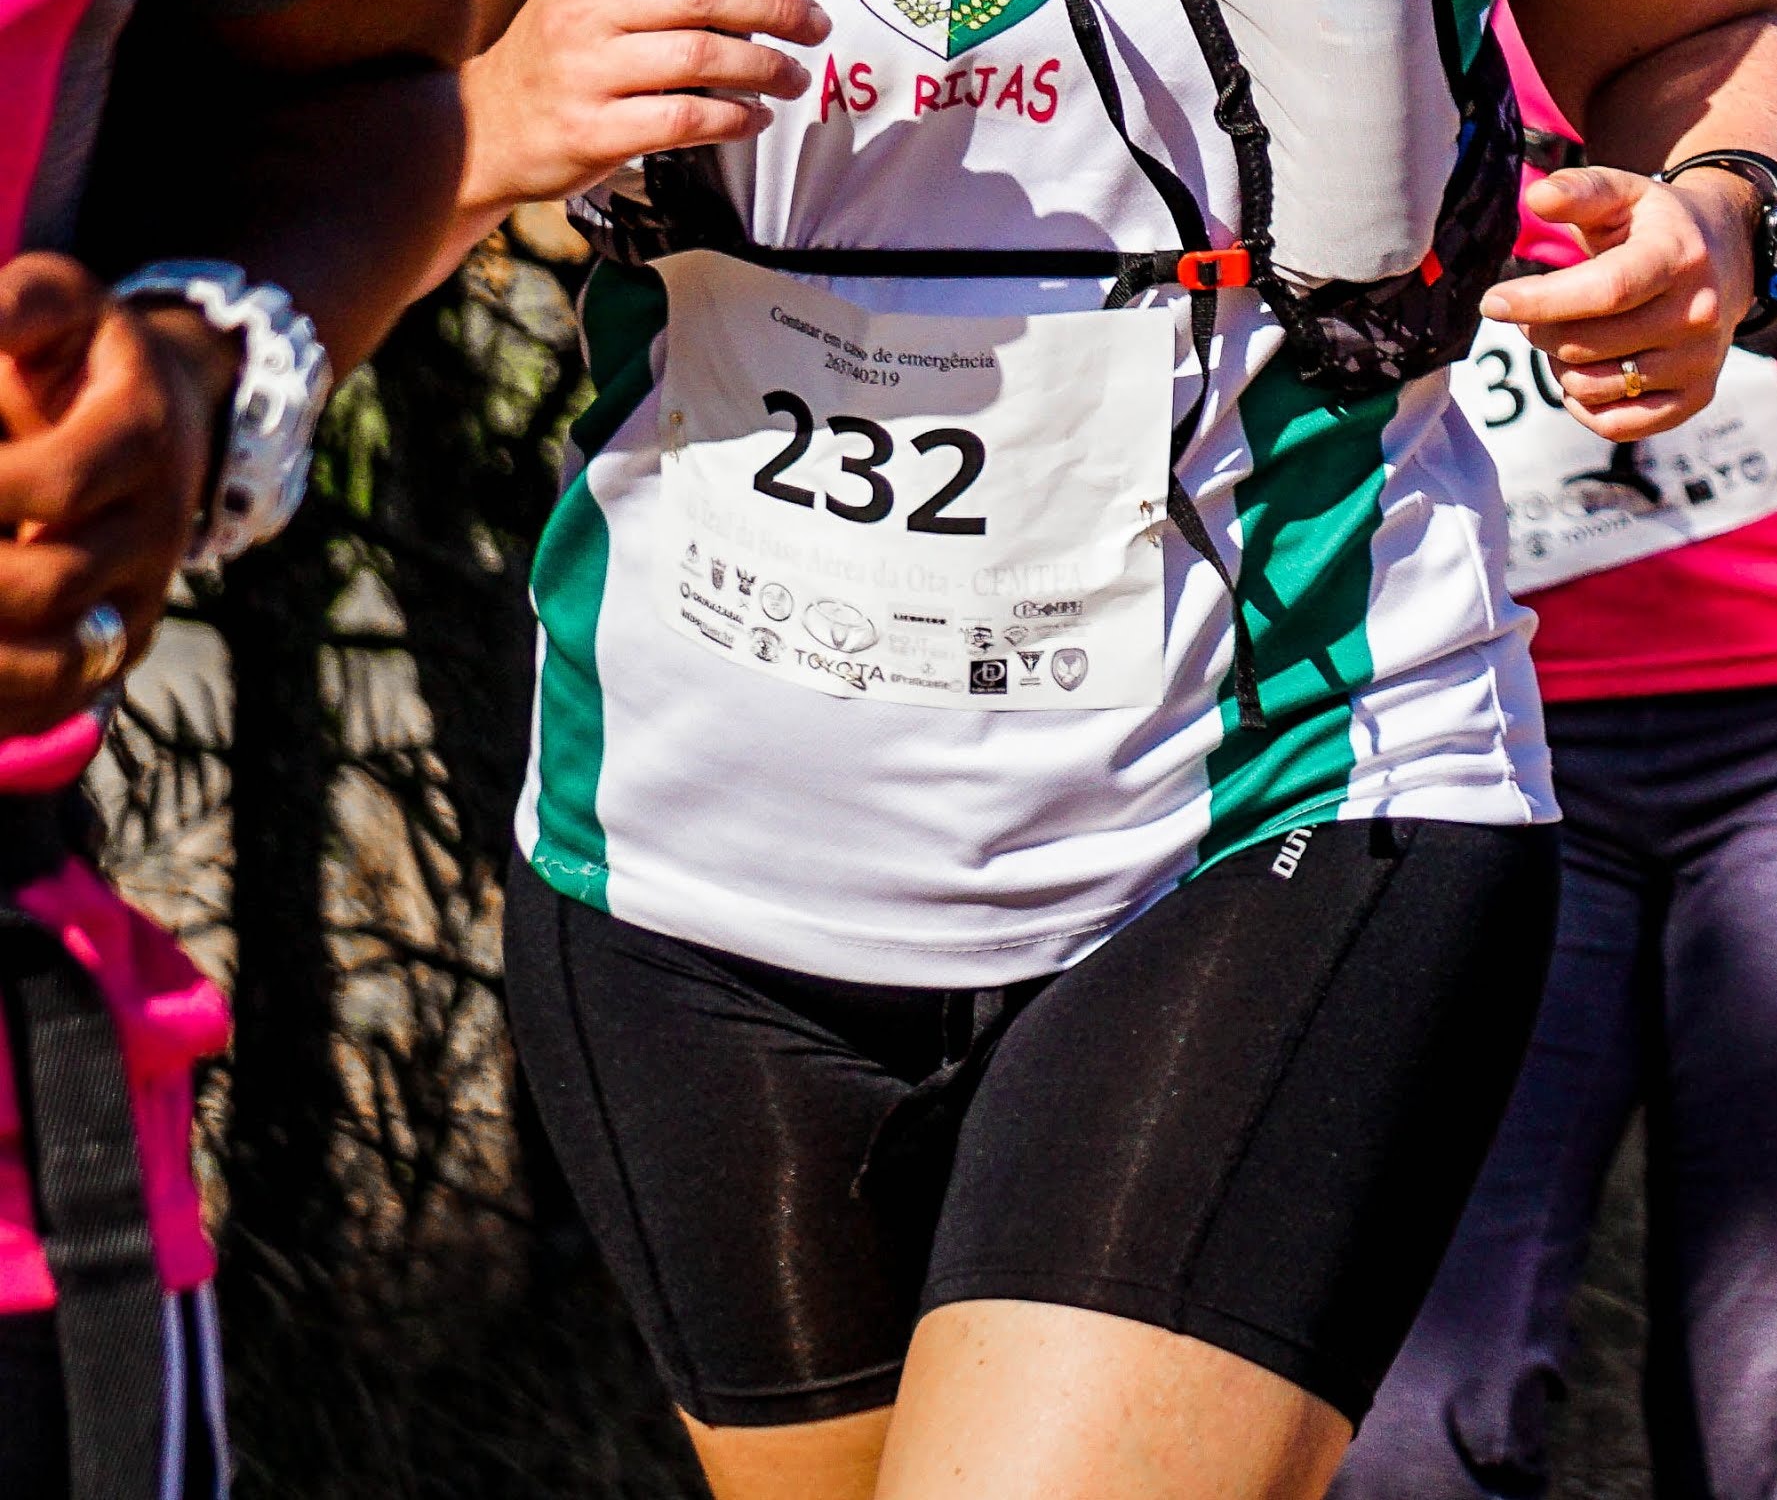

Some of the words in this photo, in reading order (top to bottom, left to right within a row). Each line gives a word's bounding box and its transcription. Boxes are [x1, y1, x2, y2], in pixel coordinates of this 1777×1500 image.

[914, 58, 1062, 124] RIJAS
[872, 346, 894, 365] de
[897, 350, 995, 373] emergência
[752, 390, 988, 536] 232
[794, 648, 886, 683] TOYOTA
